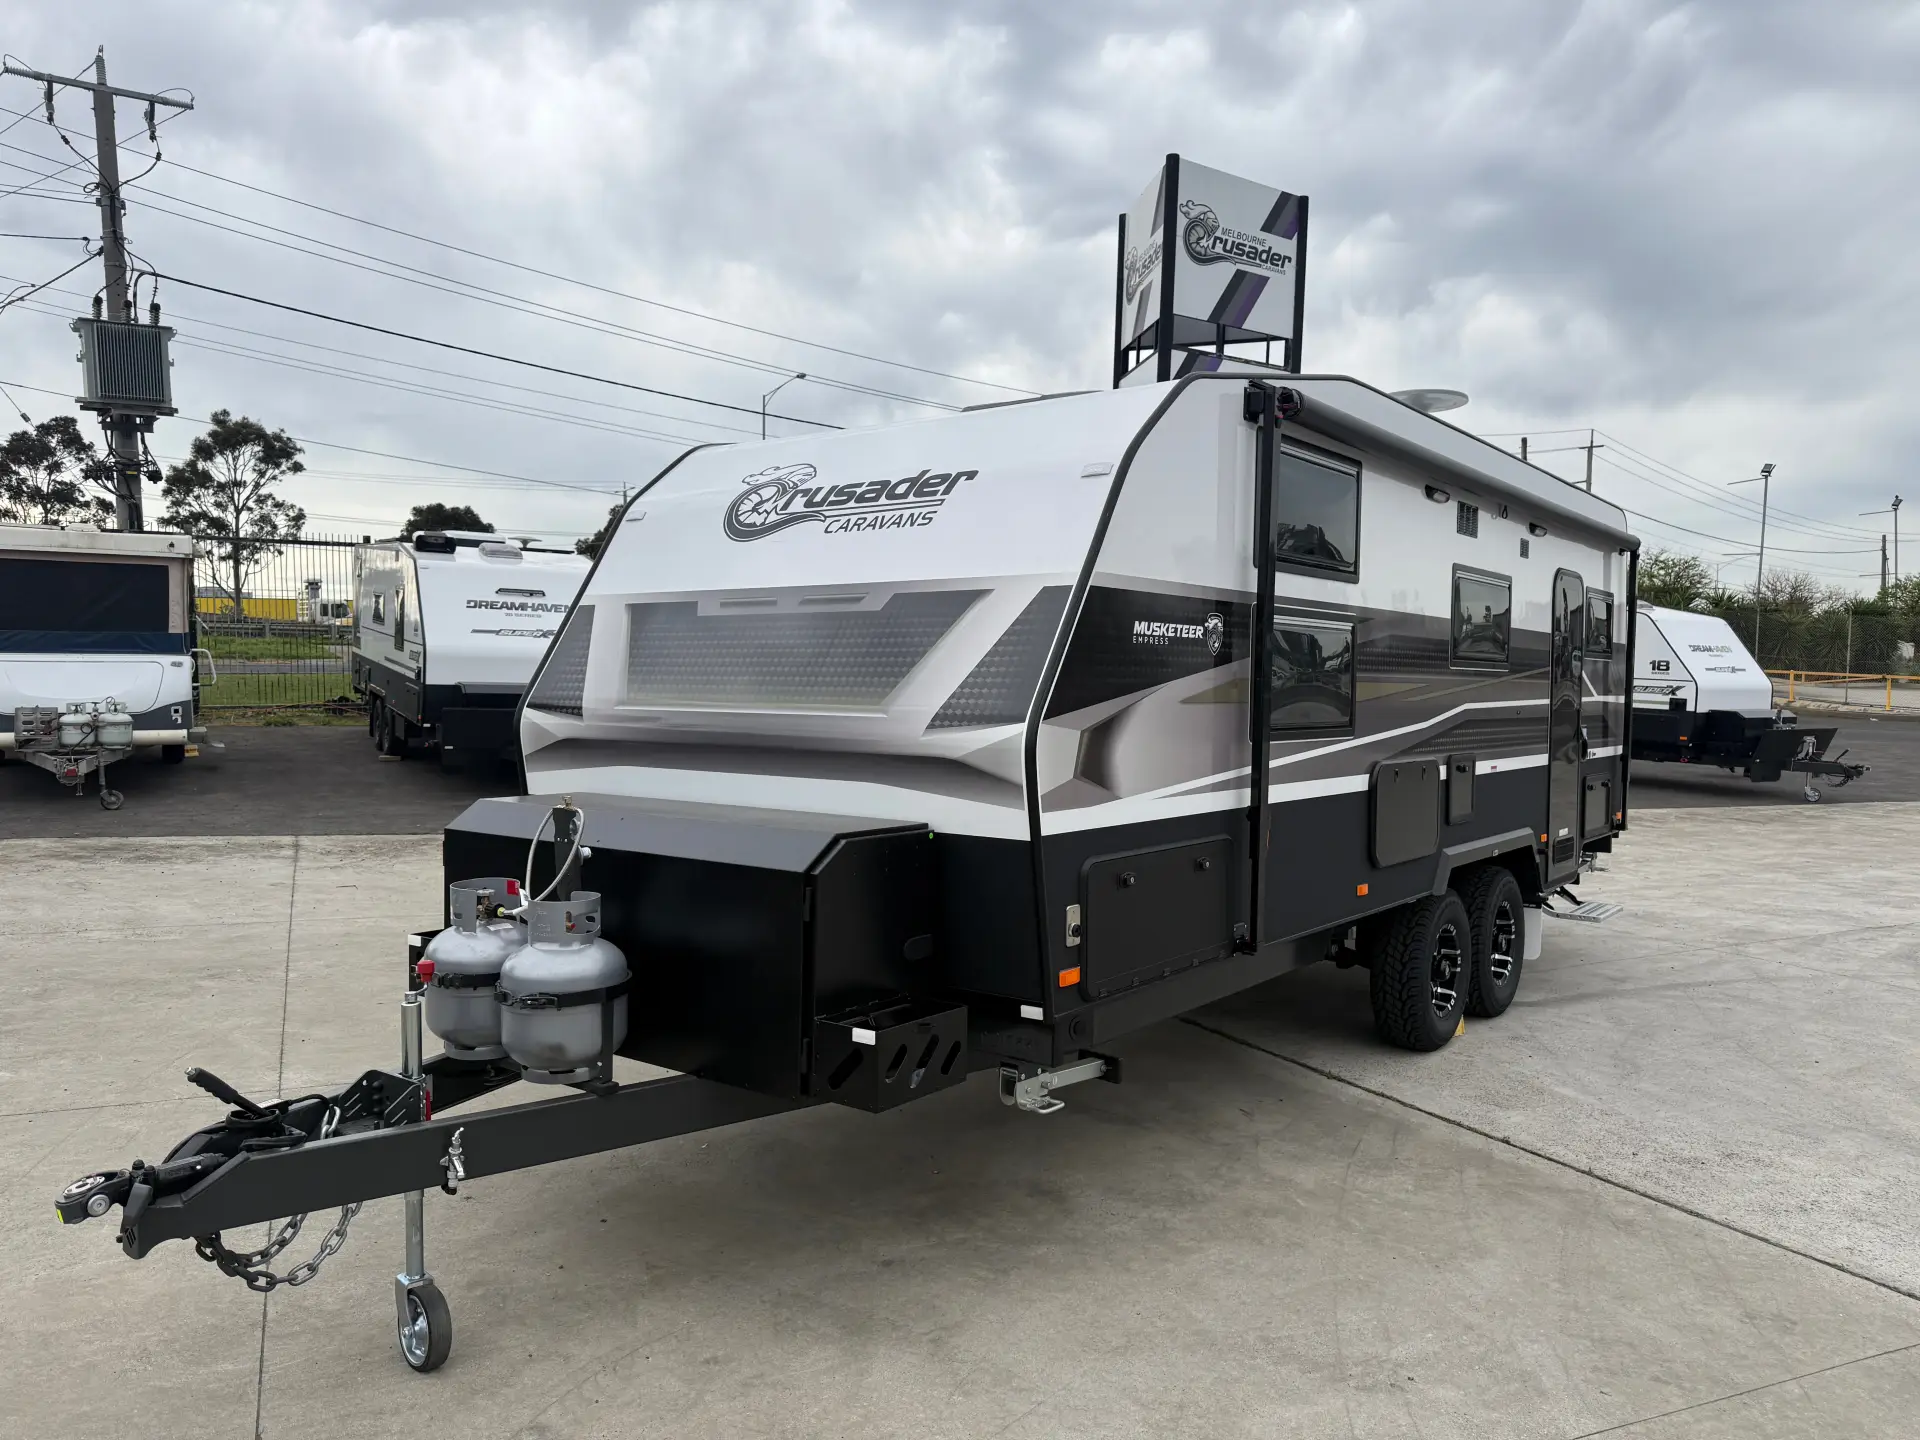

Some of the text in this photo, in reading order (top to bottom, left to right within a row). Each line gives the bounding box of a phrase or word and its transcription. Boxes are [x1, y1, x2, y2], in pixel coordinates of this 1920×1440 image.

[1220, 227, 1267, 248] MELBOURNE
[1261, 264, 1286, 275] CARAVANS
[824, 510, 938, 534] CARAVANS
[1133, 621, 1204, 638] MUSKETEER
[1132, 636, 1169, 645] EMPRESS
[1649, 660, 1670, 671] 18
